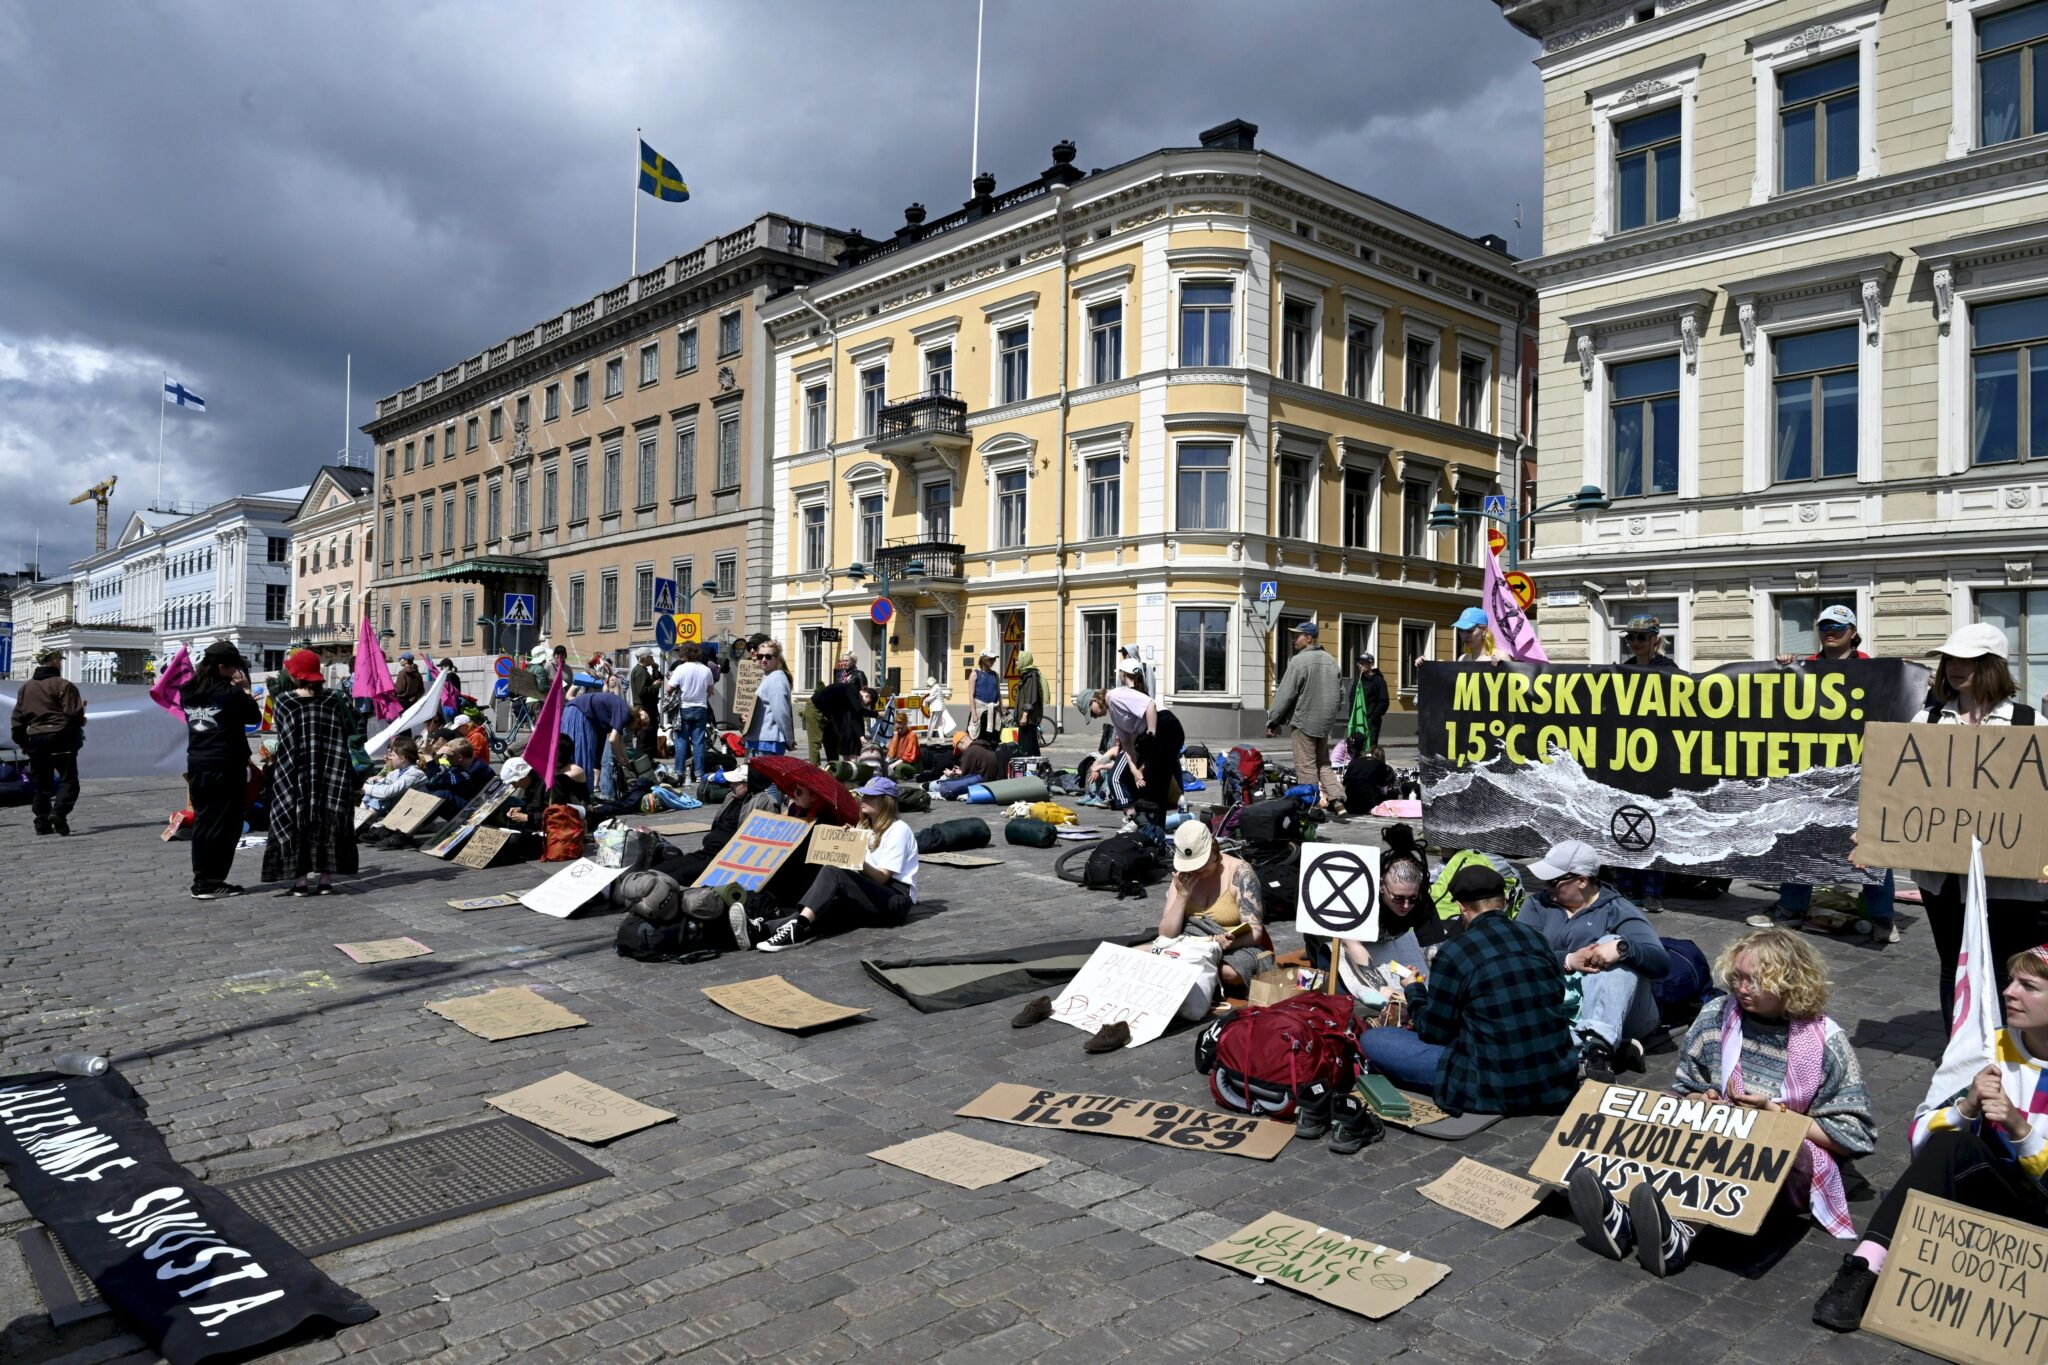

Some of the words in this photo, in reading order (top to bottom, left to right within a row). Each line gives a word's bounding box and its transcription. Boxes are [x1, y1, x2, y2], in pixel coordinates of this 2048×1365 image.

[681, 624, 693, 634] 30
[1453, 672, 1865, 720] MYRSKYVAROITUS:
[1537, 721, 1598, 768] ON
[1610, 728, 1658, 772] JO
[1888, 733, 2048, 791] AIKA
[1881, 806, 2022, 849] LOPPUU
[723, 842, 788, 868] TUET
[564, 1082, 654, 1117] HALLITUS
[1028, 1090, 1259, 1133] RATIFIOIKAA
[1010, 1104, 1114, 1127] ILO
[1146, 1120, 1248, 1150] 169
[1558, 1113, 1605, 1148] JA
[1602, 1119, 1790, 1184] KUOLEMAN
[1561, 1150, 1749, 1219] KYSYMYS
[1218, 1249, 1342, 1291] NOW!
[1227, 1235, 1364, 1282] JUSTICE
[1265, 1225, 1392, 1270] CLIMATE
[1918, 1238, 1939, 1266] EI
[1952, 1250, 2027, 1299] ODOTA
[1896, 1267, 1973, 1329] TOIMI
[1976, 1297, 2048, 1355] NYT
